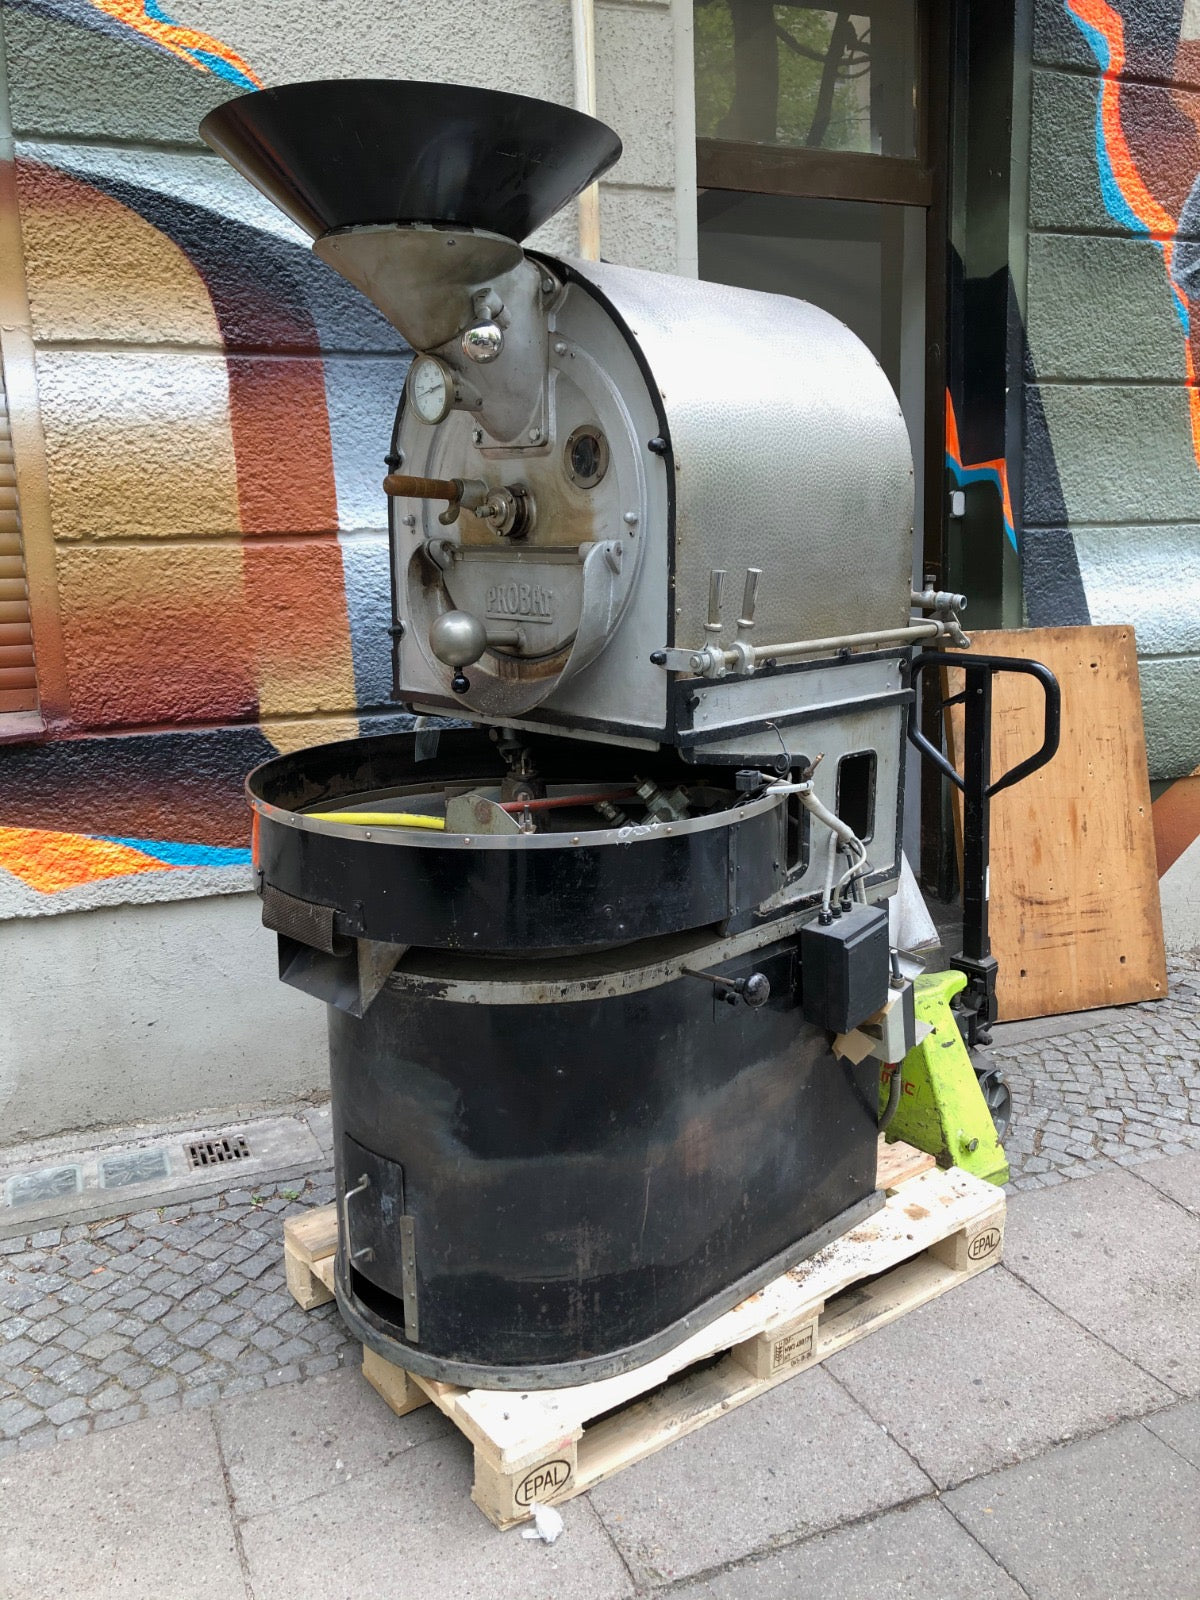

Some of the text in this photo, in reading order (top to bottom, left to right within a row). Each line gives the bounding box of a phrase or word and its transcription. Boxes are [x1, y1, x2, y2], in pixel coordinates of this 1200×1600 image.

[485, 583, 553, 617] PROBAT
[973, 1233, 995, 1257] EPAL
[524, 1467, 563, 1501] EPAL
